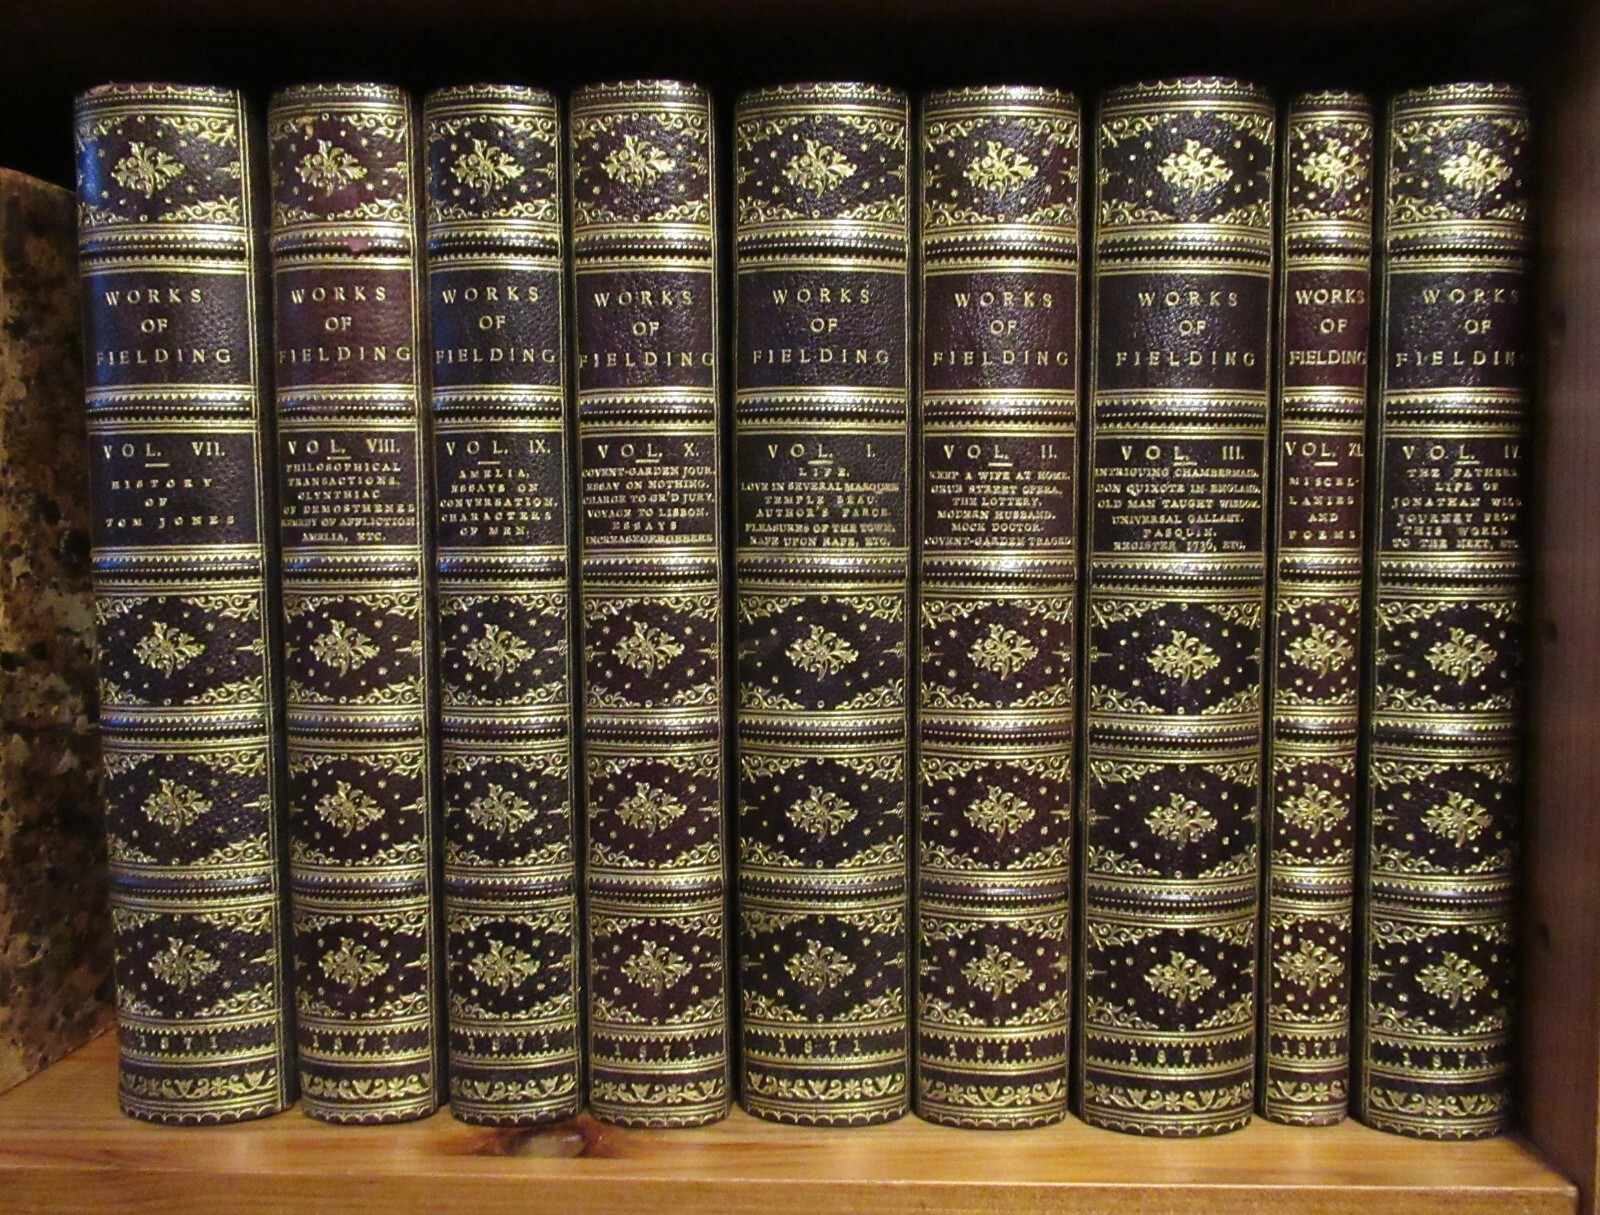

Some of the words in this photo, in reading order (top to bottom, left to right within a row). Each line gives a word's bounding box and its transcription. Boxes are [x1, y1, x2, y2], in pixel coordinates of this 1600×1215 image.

[105, 288, 201, 307] WORKS
[291, 286, 386, 305] WORKS
[442, 286, 539, 304] WORKS
[594, 290, 693, 308] WORKS
[772, 288, 870, 304] WORKS
[954, 291, 1052, 308] WORKS
[1138, 291, 1238, 308] WORKS
[1295, 289, 1365, 305] WORKS
[1422, 288, 1519, 305] WORKS
[140, 318, 168, 334] OF
[324, 317, 352, 331] OF
[478, 315, 506, 330] OF
[632, 321, 660, 336] OF
[810, 318, 839, 333] OF
[990, 320, 1017, 335] OF
[1178, 320, 1206, 336] OF
[1320, 318, 1348, 334] OF
[1465, 319, 1492, 335] OF
[96, 348, 231, 367] FIELDING
[279, 346, 411, 365] FIELDING
[435, 347, 556, 364] FIELDING
[579, 351, 714, 369] FIELDING
[753, 349, 890, 365] FIELDING
[933, 350, 1069, 367] FIELDING
[1115, 351, 1255, 367] FIELDING
[1289, 349, 1368, 366] FIELDING
[1395, 350, 1522, 368] FIELDIN
[103, 442, 162, 460] VOL.
[191, 441, 226, 457] VII.
[366, 439, 401, 453] VIII.
[446, 440, 508, 456] VOL.
[529, 439, 551, 454] IX.
[598, 443, 663, 459] VOL.
[683, 442, 699, 457] X.
[768, 444, 834, 459] VOL.
[866, 443, 876, 458] I.
[1040, 444, 1058, 459] II.
[1222, 445, 1245, 460] III.
[1285, 441, 1336, 458] VOL.
[1402, 444, 1475, 461] VOL.
[286, 462, 402, 473] PHILOSOPHICAL
[1094, 467, 1170, 478] INTRIGUING
[1407, 468, 1441, 478] THE
[965, 471, 973, 481] A
[978, 471, 1010, 481] WIFE
[1015, 470, 1032, 480] AT
[111, 478, 213, 490] HISTORY
[451, 483, 505, 493] ESSAYS
[517, 483, 539, 493] ON
[586, 481, 620, 492] ESSAY
[626, 480, 643, 490] ON
[741, 482, 769, 492] LOVE
[771, 482, 784, 491] IN
[787, 481, 843, 491] SEVERAL
[969, 484, 1018, 494] STREET
[1096, 483, 1121, 494] DON
[1126, 483, 1185, 497] QUIXOTE
[1190, 483, 1205, 494] IN
[1482, 482, 1500, 492] OF
[145, 497, 168, 507] OF
[630, 494, 646, 503] TO
[764, 496, 825, 505] TEMPLE
[952, 497, 978, 506] THE
[1097, 499, 1123, 509] OLD
[1127, 499, 1156, 509] MAN
[1162, 499, 1214, 509] TAUGHT
[1289, 495, 1355, 506] LANIES
[1391, 497, 1481, 510] JONATHAN
[283, 506, 297, 515] OF
[303, 504, 415, 514] DEMOSTHENES
[441, 511, 552, 522] CHARACTERS
[587, 508, 632, 518] VOYAGE
[638, 508, 654, 517] TO
[756, 506, 829, 518] AUTHOR'S
[936, 510, 989, 520] MODERN
[105, 517, 143, 528] TOM
[158, 515, 235, 529] JONES
[321, 518, 337, 526] OF
[1112, 513, 1183, 525] UNIVERSAL
[1307, 512, 1339, 523] AND
[1396, 513, 1473, 527] JOURNEY
[459, 527, 478, 536] OF
[612, 521, 677, 531] ESSAYS
[812, 524, 829, 534] OF
[831, 523, 857, 533] THE
[951, 522, 986, 532] MOCK
[1402, 526, 1443, 537] THIS
[1456, 526, 1508, 536] WORLD
[783, 537, 817, 547] UPON
[1288, 530, 1356, 540] POEMS
[1113, 540, 1176, 551] REGISTER
[1391, 538, 1411, 549] TO
[1419, 538, 1448, 549] THE
[778, 1039, 861, 1053] 1871
[949, 1044, 1032, 1059] 1871
[1130, 1048, 1214, 1064] 1871
